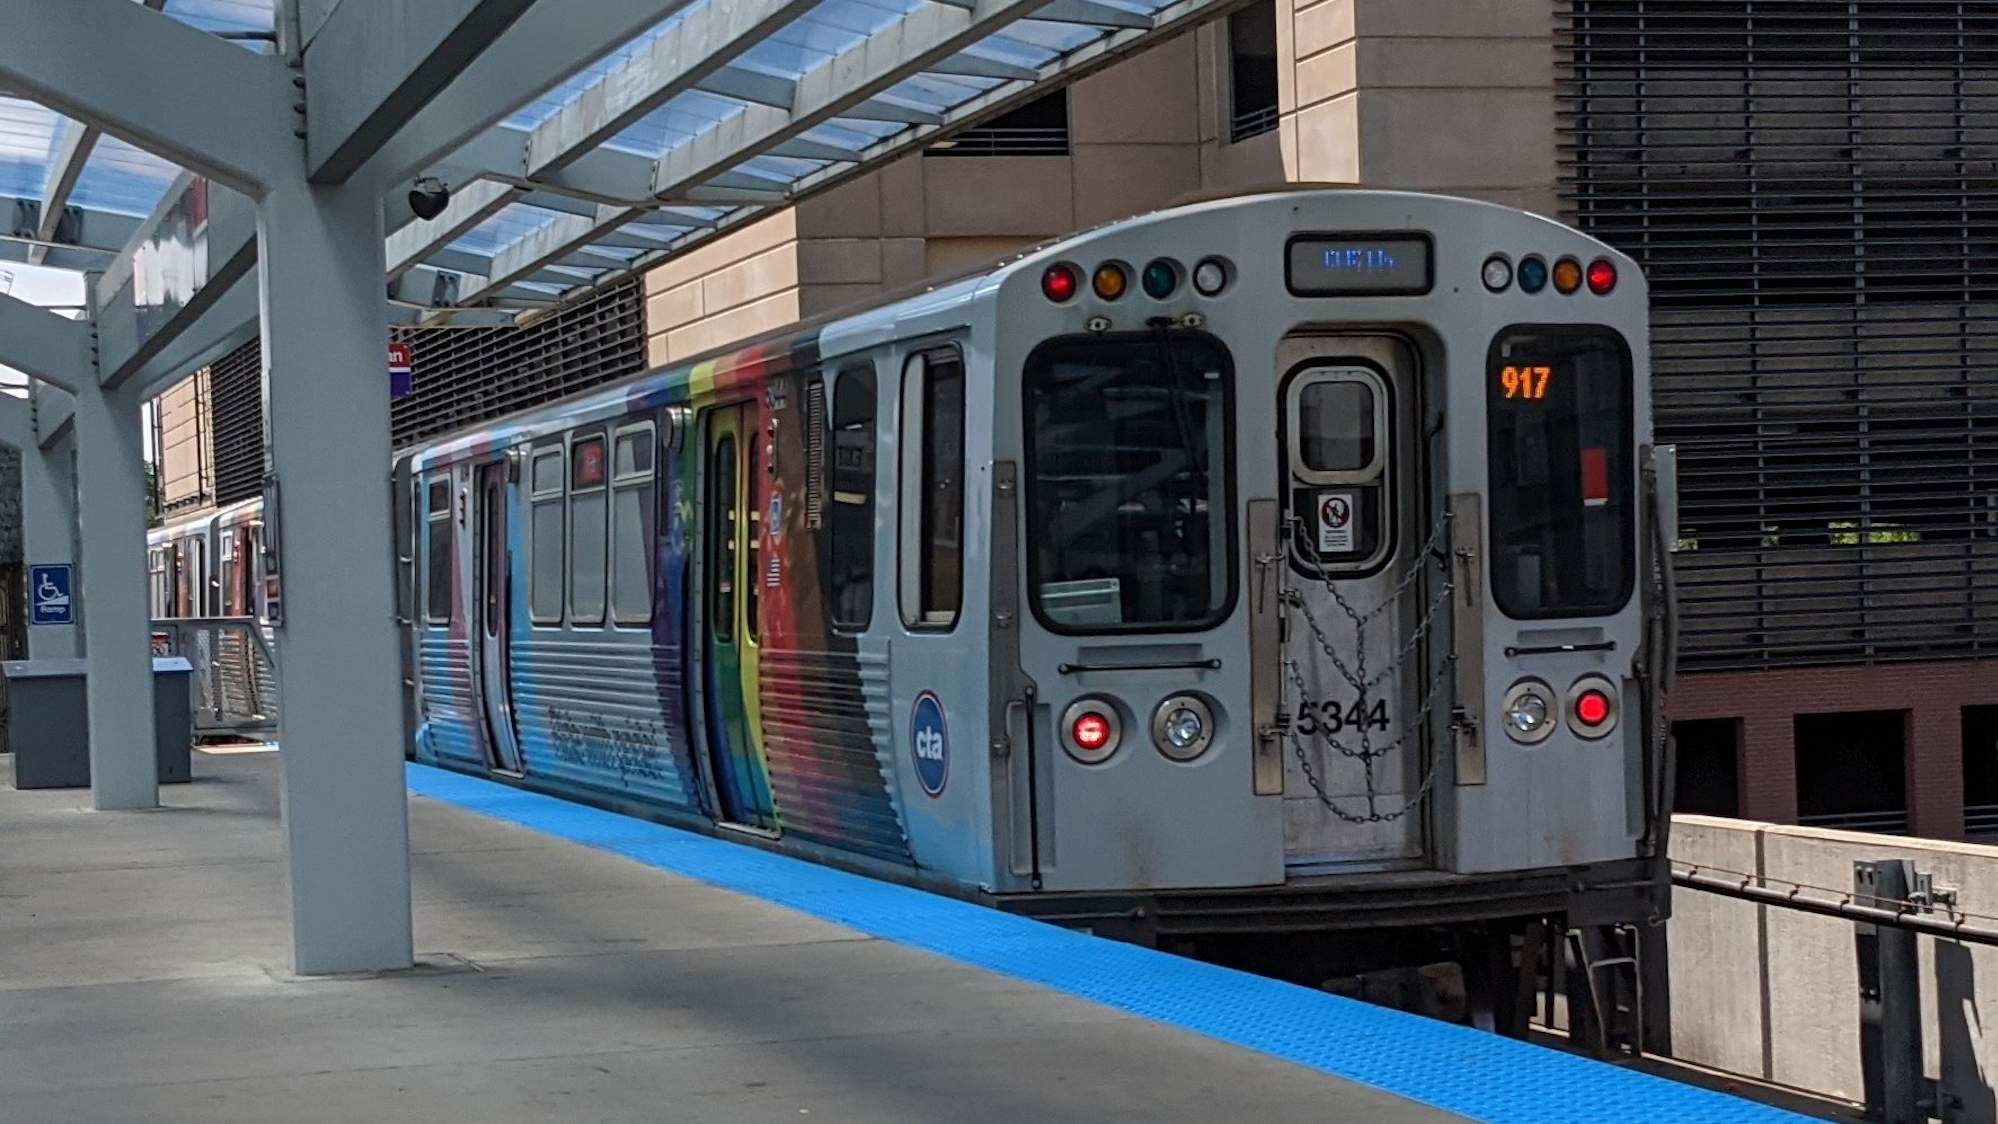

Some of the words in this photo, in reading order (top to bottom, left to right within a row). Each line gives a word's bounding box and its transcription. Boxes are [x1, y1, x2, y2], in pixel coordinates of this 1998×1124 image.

[1501, 366, 1551, 399] 917
[40, 605, 66, 614] Ramp
[1297, 698, 1390, 736] 5344
[916, 725, 943, 760] cta
